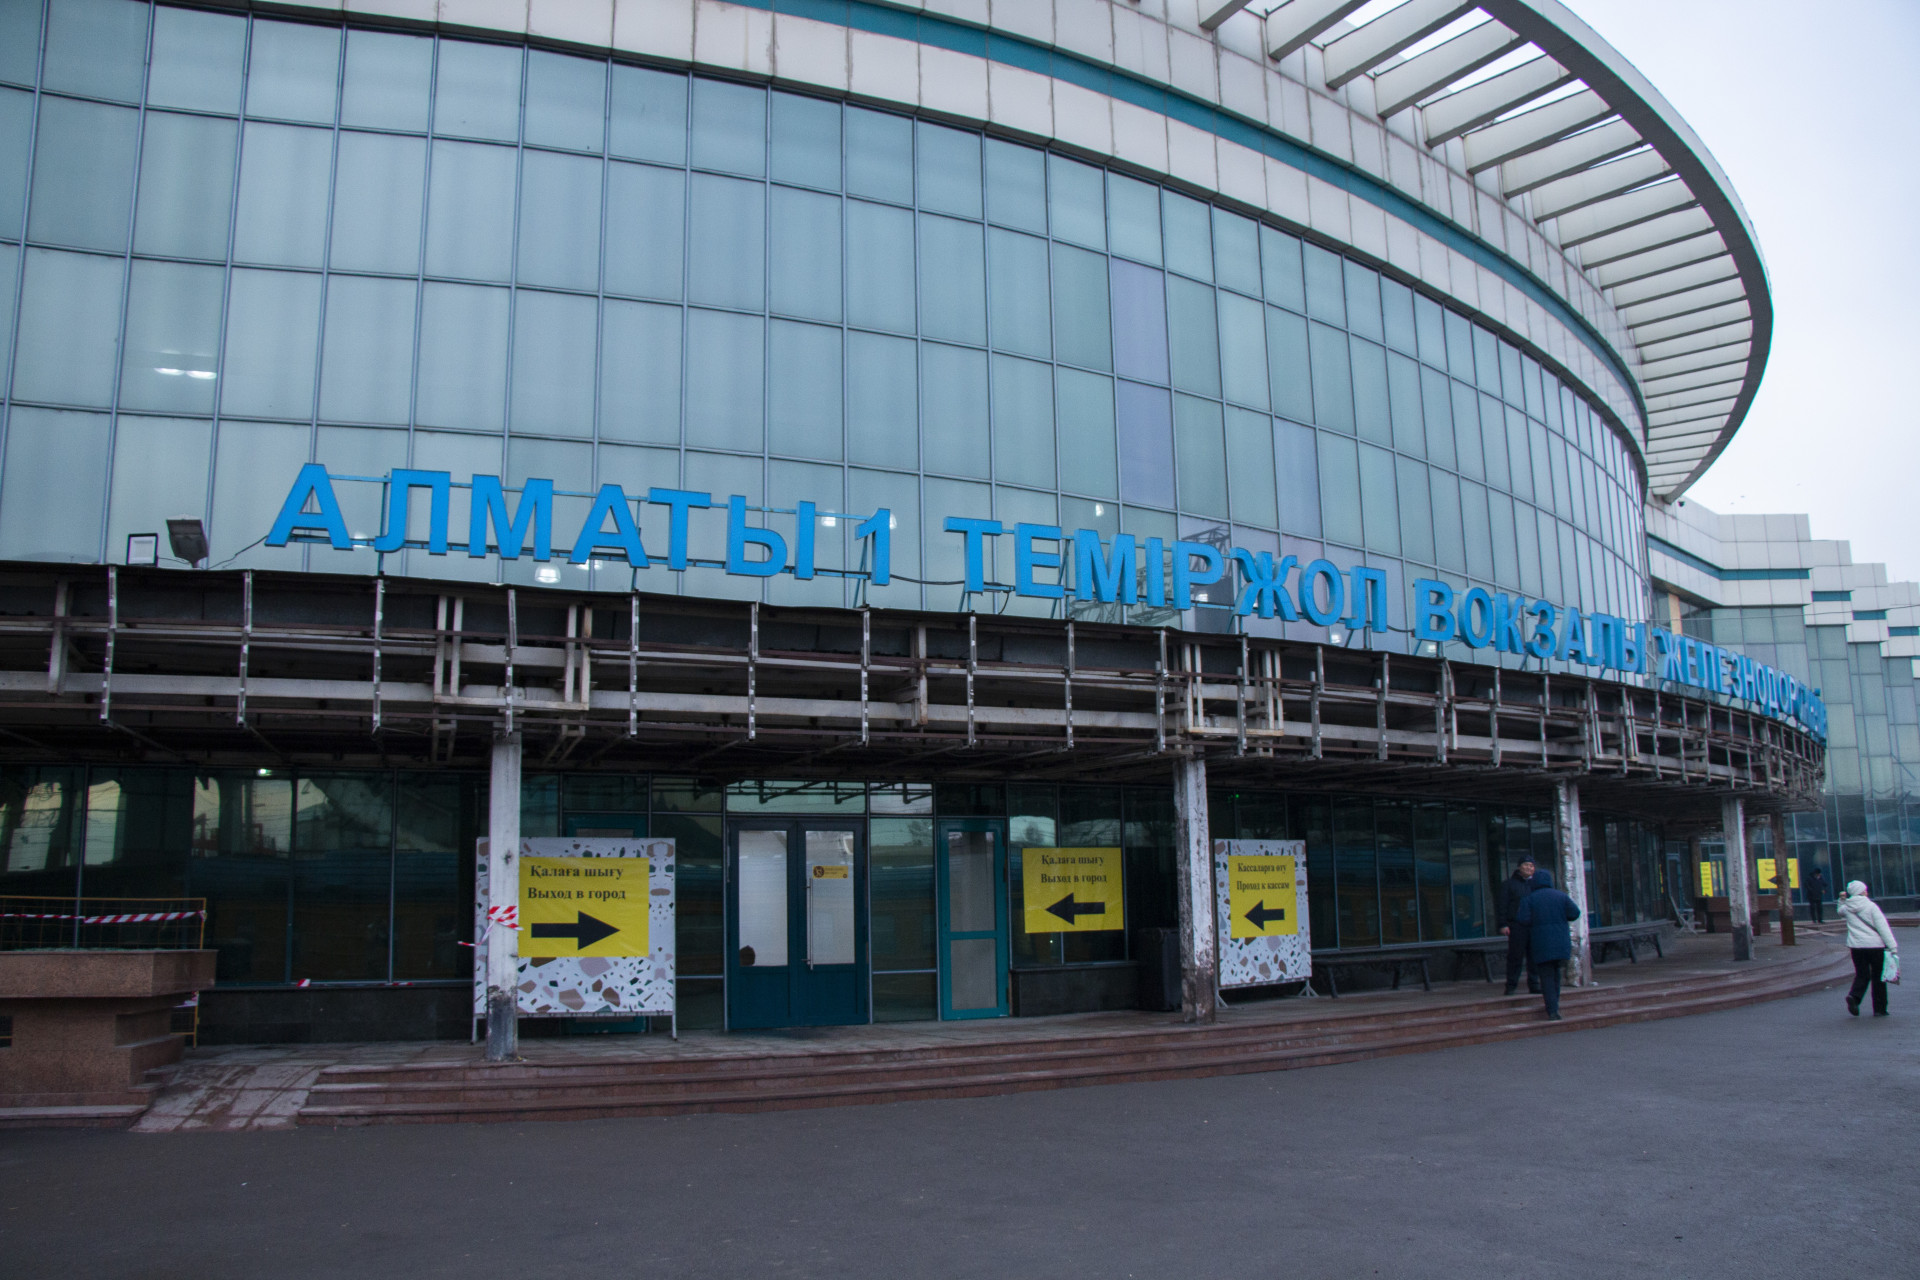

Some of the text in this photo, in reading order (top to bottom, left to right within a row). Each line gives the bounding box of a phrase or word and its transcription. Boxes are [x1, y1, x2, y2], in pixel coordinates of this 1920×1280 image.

[264, 463, 816, 580] АЛМАТЫ
[855, 508, 891, 586] 1
[1413, 578, 1647, 675] ВОКЗАЛЫ
[530, 864, 624, 880] Қалаға шығу
[1040, 873, 1072, 884] Выход
[1081, 874, 1108, 885] город
[527, 886, 626, 902] Выход в город
[1236, 880, 1261, 892] Проход
[1267, 882, 1290, 890] кассам
